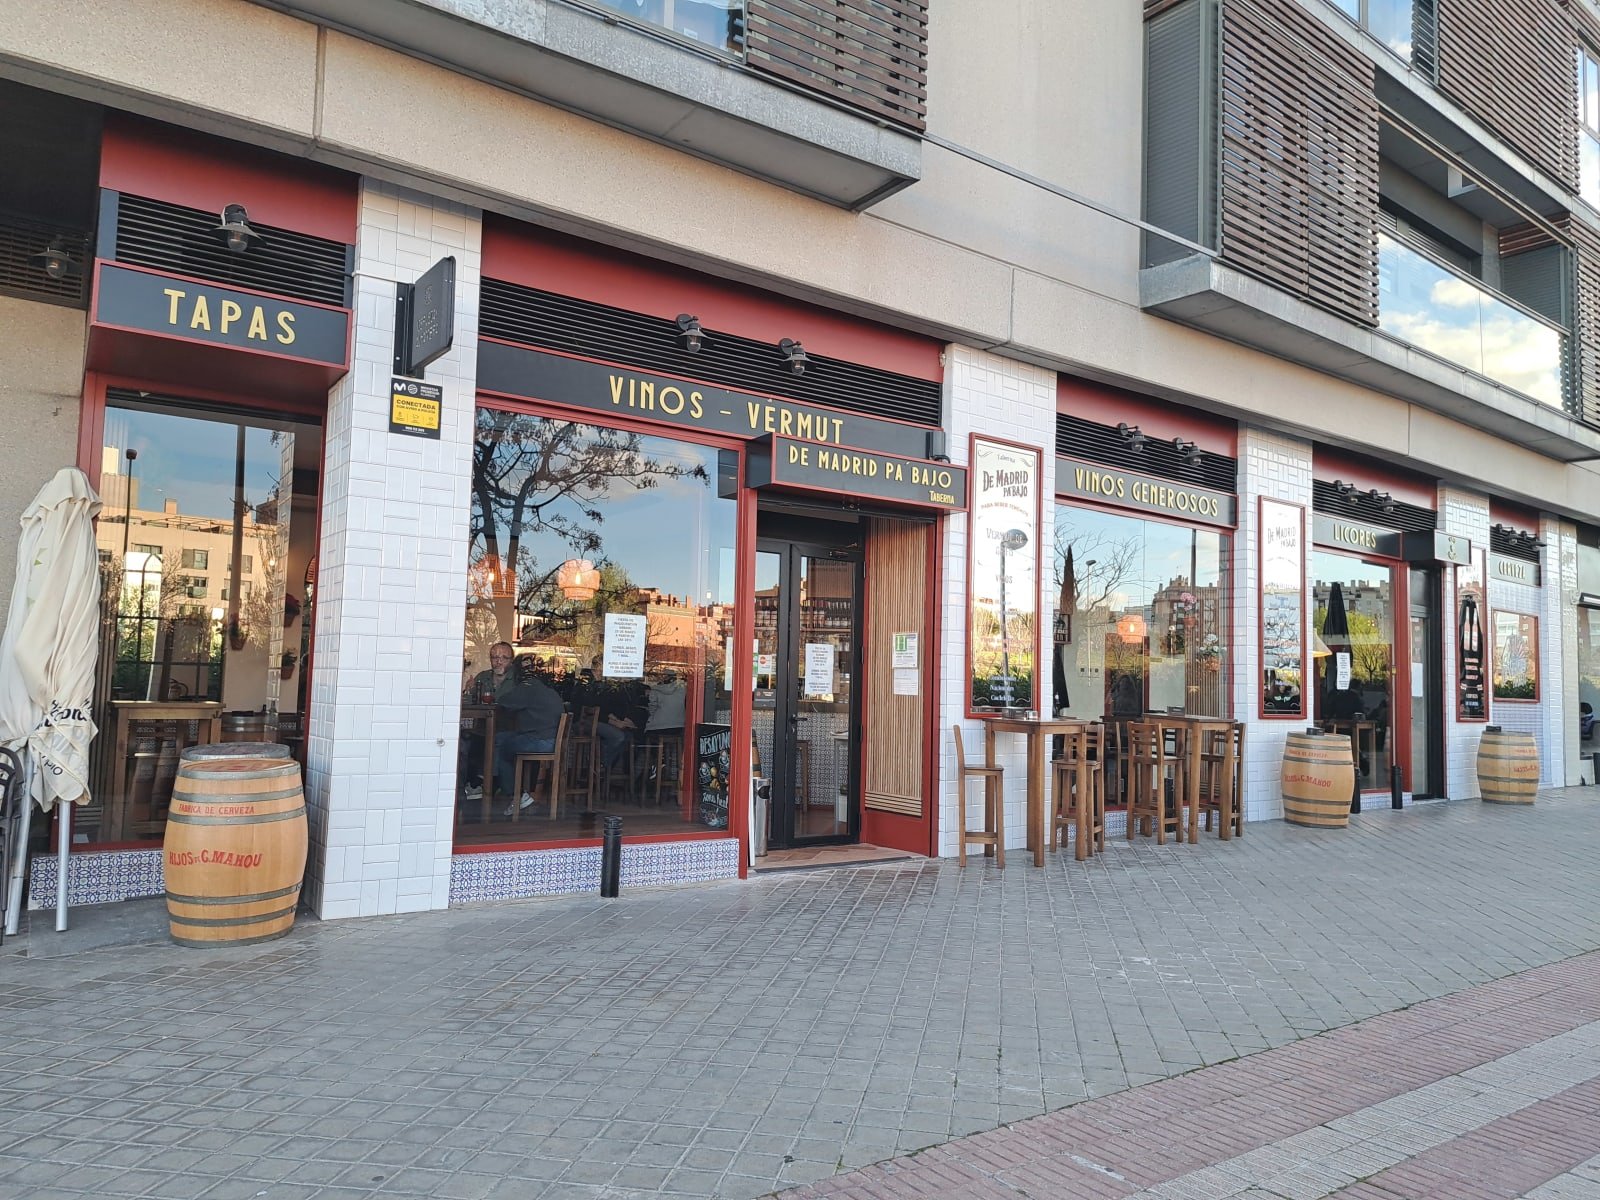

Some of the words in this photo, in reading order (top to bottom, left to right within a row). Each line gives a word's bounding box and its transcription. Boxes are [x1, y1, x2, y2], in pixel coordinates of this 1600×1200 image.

[164, 288, 296, 345] TAPAS
[396, 399, 436, 410] CONECTADA
[609, 375, 703, 419] VINOS
[789, 444, 809, 466] DE
[818, 450, 877, 477] MADRID
[996, 469, 1028, 488] MADRID
[1075, 468, 1124, 497] VINOS
[1132, 481, 1218, 517] GENEROSOS
[1334, 523, 1377, 549] LICORES
[205, 806, 215, 814] DE
[219, 806, 255, 815] CERVEZA
[169, 851, 193, 866] HIJOS
